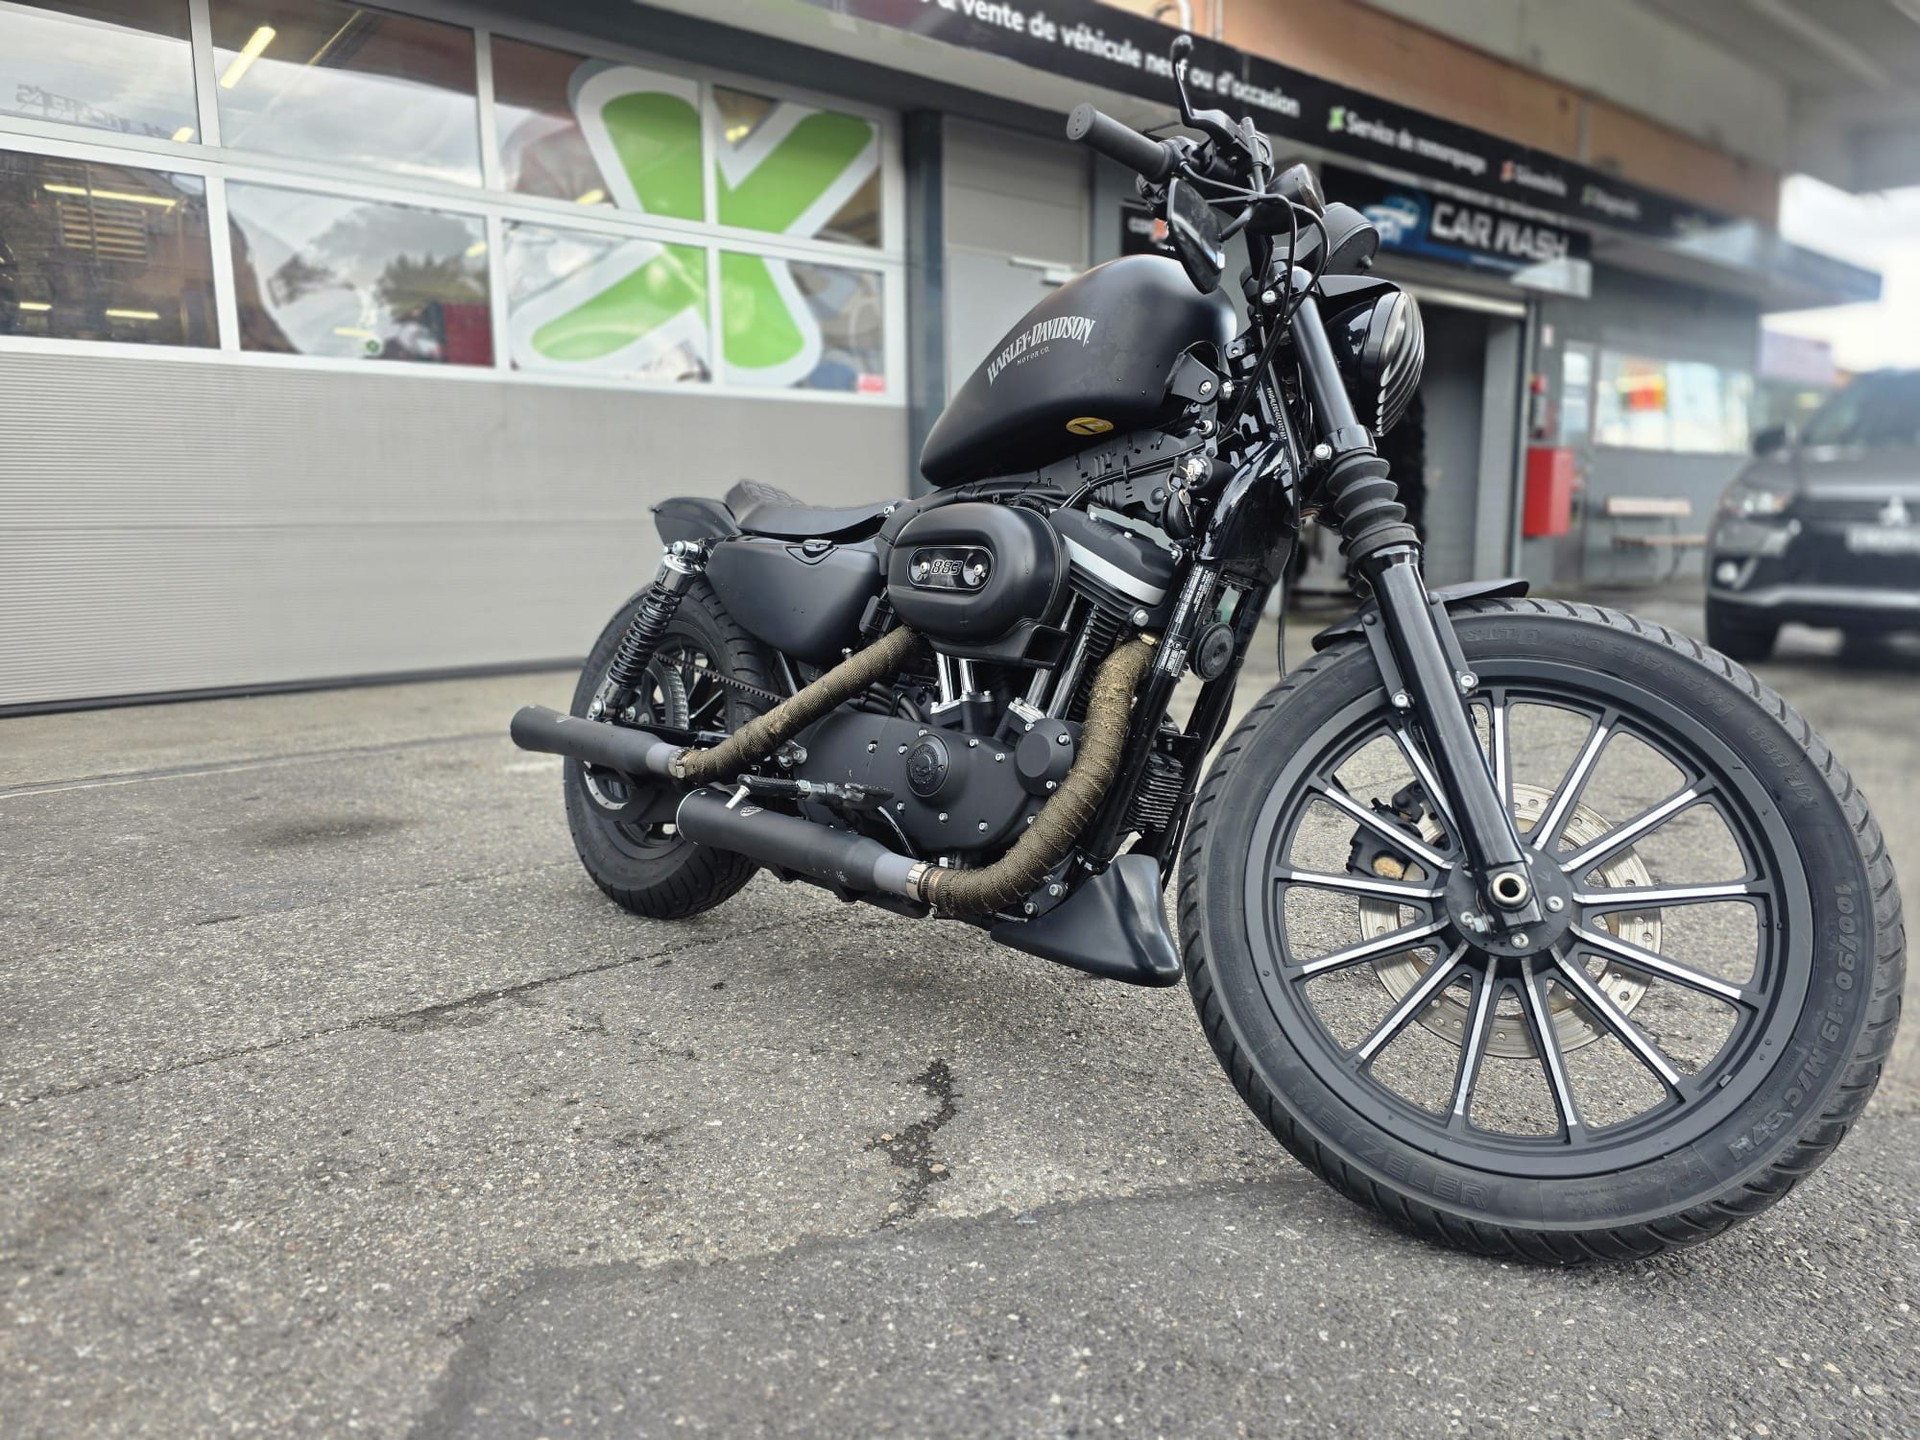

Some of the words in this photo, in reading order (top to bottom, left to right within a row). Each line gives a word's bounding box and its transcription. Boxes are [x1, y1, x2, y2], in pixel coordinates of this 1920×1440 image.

[961, 0, 1025, 32] vente
[1029, 12, 1057, 42] de
[1060, 23, 1142, 68] véhicule
[1189, 67, 1214, 91] ou
[1216, 71, 1300, 119] d'occasion
[1431, 203, 1493, 248] CAR
[1494, 222, 1569, 262] WASH
[930, 559, 964, 576] 883
